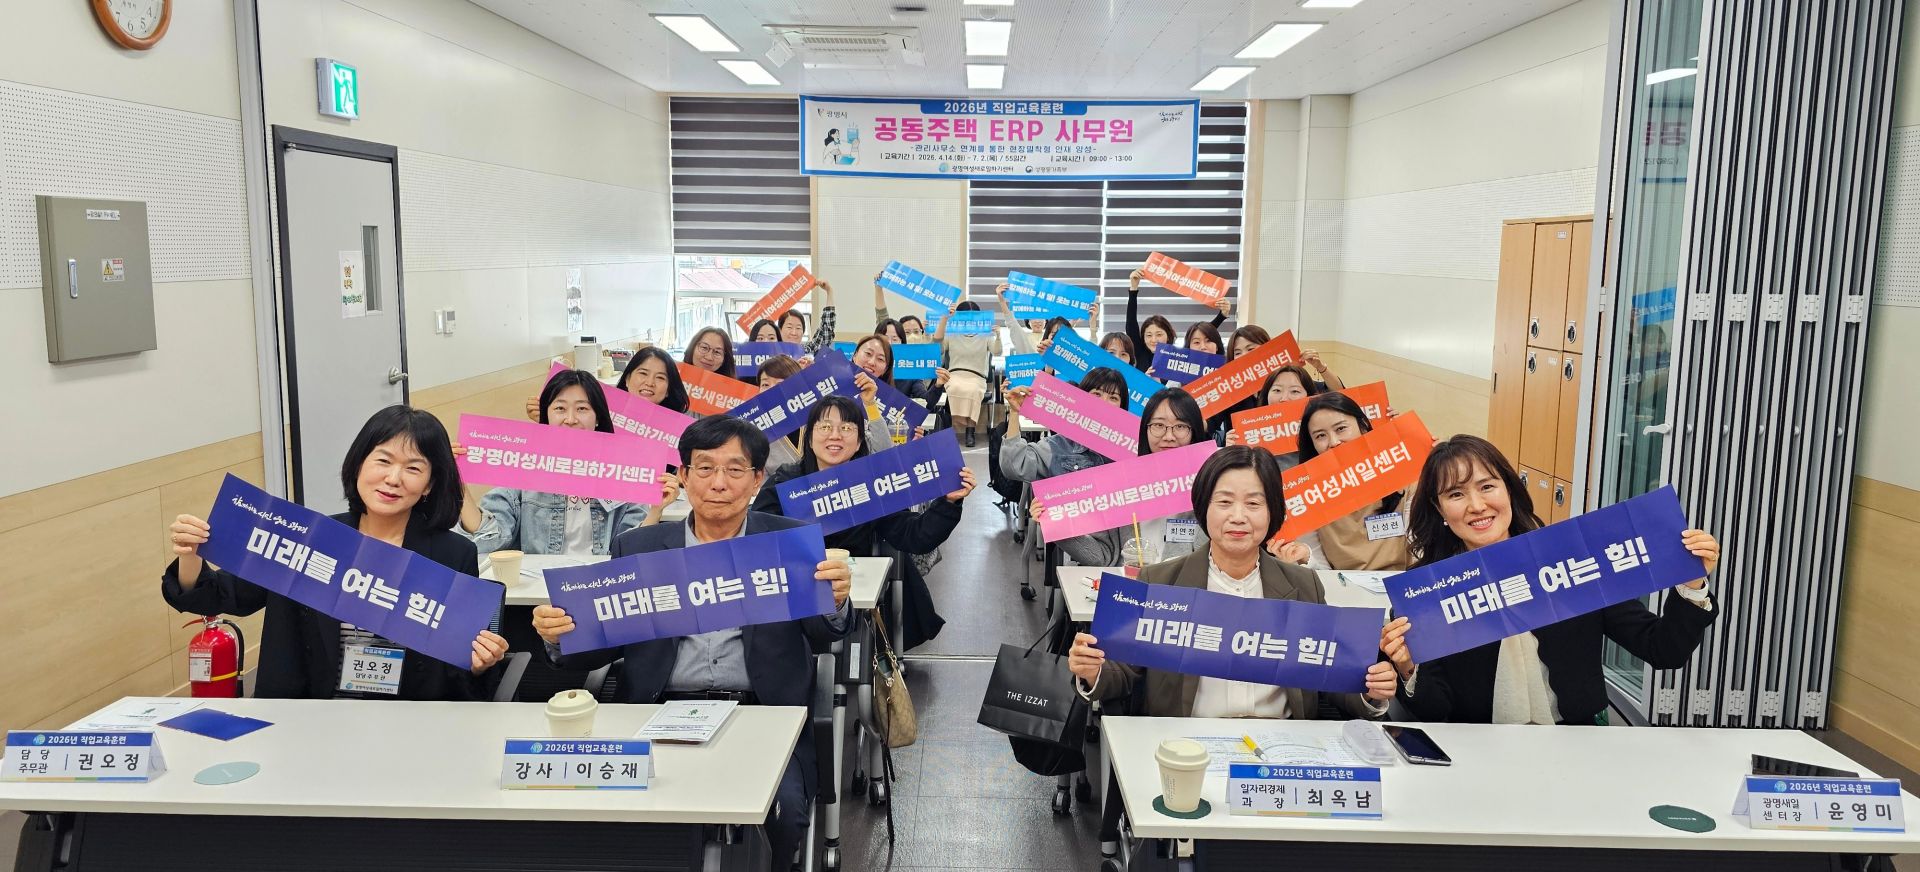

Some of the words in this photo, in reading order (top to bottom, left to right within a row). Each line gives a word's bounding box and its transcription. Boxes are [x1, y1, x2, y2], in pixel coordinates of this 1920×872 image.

[127, 20, 134, 32] 6
[944, 102, 987, 114] 2026년
[992, 103, 1064, 115] 직업교육훈련
[874, 117, 977, 143] 공동주택
[990, 119, 1043, 141] ERP
[1055, 119, 1133, 143] 사무원
[884, 153, 910, 161] 교육기간
[1056, 155, 1081, 163] 교육시간
[1148, 263, 1220, 299] 광명시여성비전센터
[915, 359, 925, 368] 내
[926, 359, 937, 368] 일!
[1052, 344, 1088, 372] 함께하는
[1167, 358, 1200, 376] 미래를
[1195, 349, 1293, 409] 광명여성새일센터
[749, 404, 787, 431] 래를
[786, 390, 818, 414] 여는
[817, 376, 839, 396] 힘!
[1130, 390, 1143, 403] 내
[466, 445, 656, 485] 광명여성새로일하기센터
[812, 482, 871, 518] 미래를
[873, 472, 912, 497] 여는
[913, 459, 940, 484] 힘!
[1286, 441, 1413, 518] 명여성새일센터
[246, 527, 338, 585] 미래를
[341, 568, 400, 610] 여는
[404, 592, 446, 630] 힘!
[1439, 573, 1534, 625] 미래를
[1538, 555, 1601, 593] 여는
[1604, 536, 1651, 573] 힘!
[593, 583, 682, 622] 미래를
[688, 575, 745, 607] 여는
[750, 567, 790, 597] 힘!
[1135, 617, 1224, 653] 미래를
[1231, 630, 1288, 660] 여는
[1297, 637, 1338, 667] 힘!
[353, 659, 392, 674] 권오정
[1007, 691, 1022, 701] THE
[1024, 695, 1048, 707] IZZAT
[48, 735, 78, 745] 2026년
[80, 735, 127, 745] 직업교육훈련
[545, 743, 575, 753] 2026년
[577, 743, 623, 753] 직업교육훈련
[18, 763, 48, 774] 주무관
[78, 753, 140, 771] 권오정
[515, 762, 553, 780] 강사
[577, 762, 638, 780] 이승재
[1272, 767, 1304, 778] 2025년
[1306, 768, 1354, 780] 직업교육훈련
[1240, 783, 1286, 795] 일자리경제
[1789, 782, 1821, 793] 2026년
[1823, 783, 1872, 794] 직업교육훈련
[1307, 788, 1372, 809] 최옥남
[1762, 797, 1800, 809] 광명새일
[1762, 811, 1802, 822] 센터장
[1828, 802, 1892, 822] 윤영미
